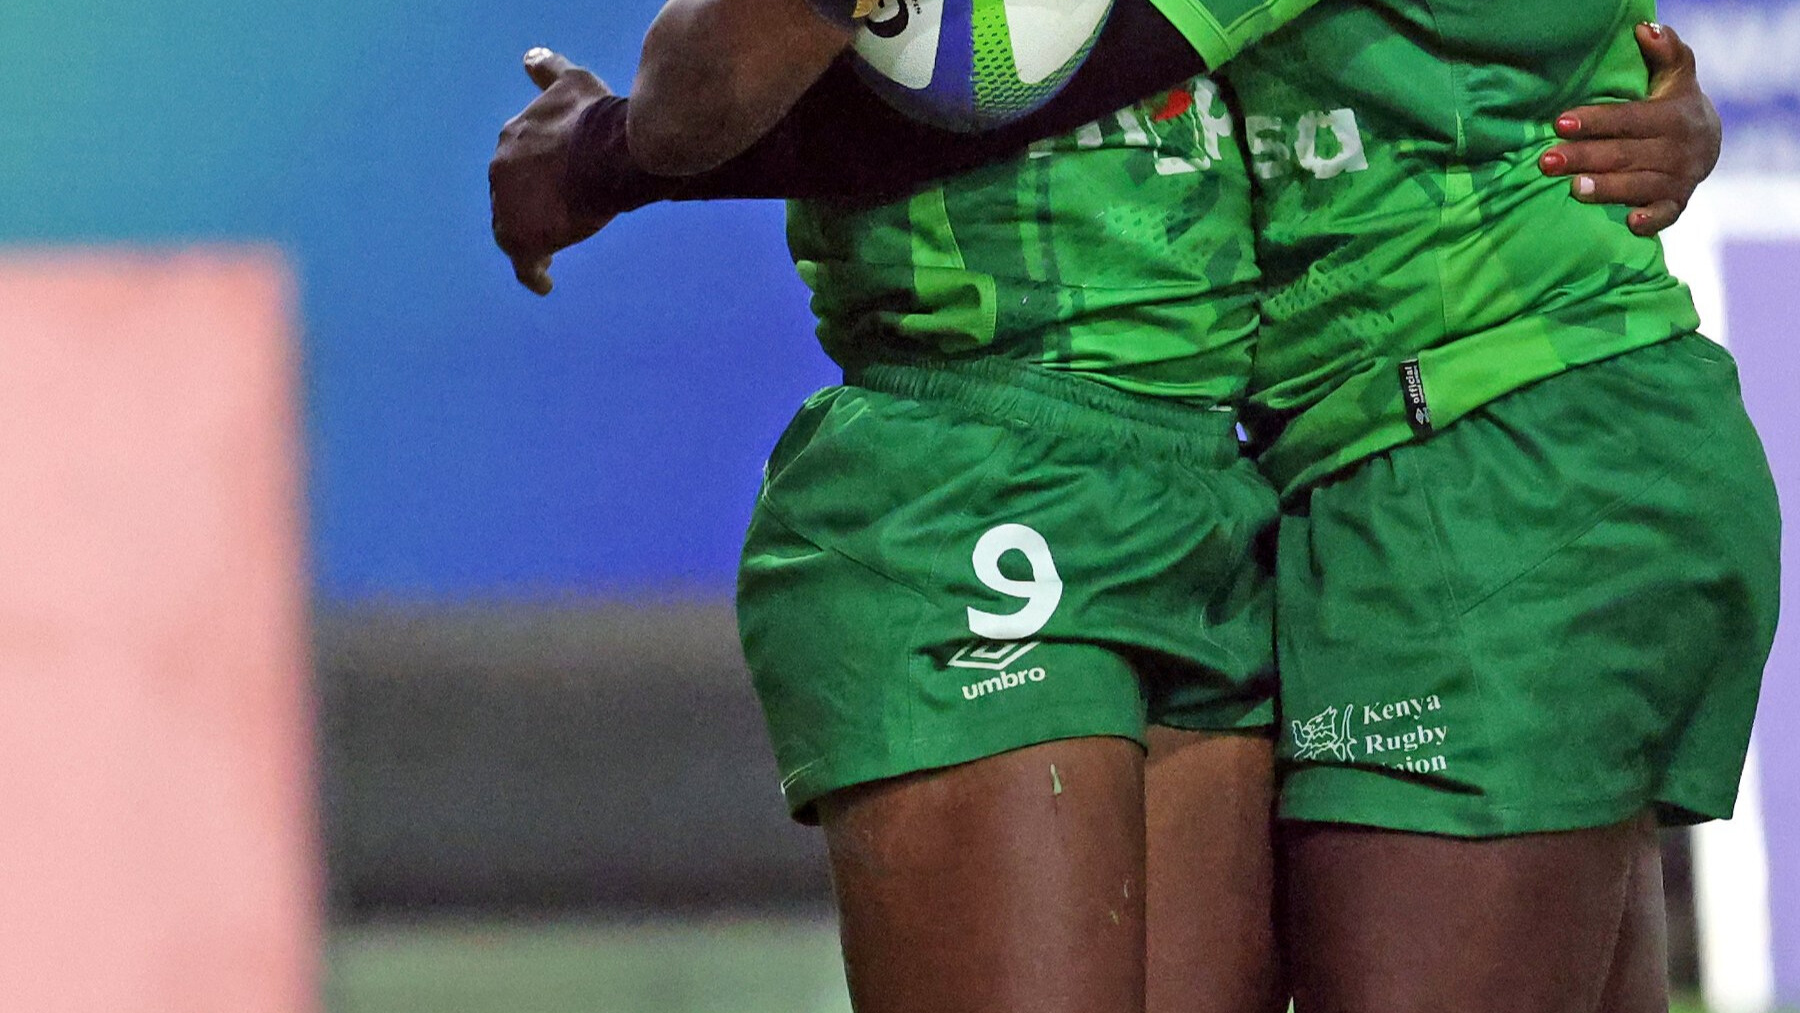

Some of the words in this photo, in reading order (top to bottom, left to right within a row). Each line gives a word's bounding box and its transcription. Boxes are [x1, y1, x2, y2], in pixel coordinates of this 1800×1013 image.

[1403, 365, 1421, 405] official
[966, 523, 1063, 640] 9
[961, 666, 1046, 701] umbro
[1363, 693, 1442, 725] Kenya
[1364, 724, 1448, 753] Rugby
[1381, 754, 1448, 775] ion
